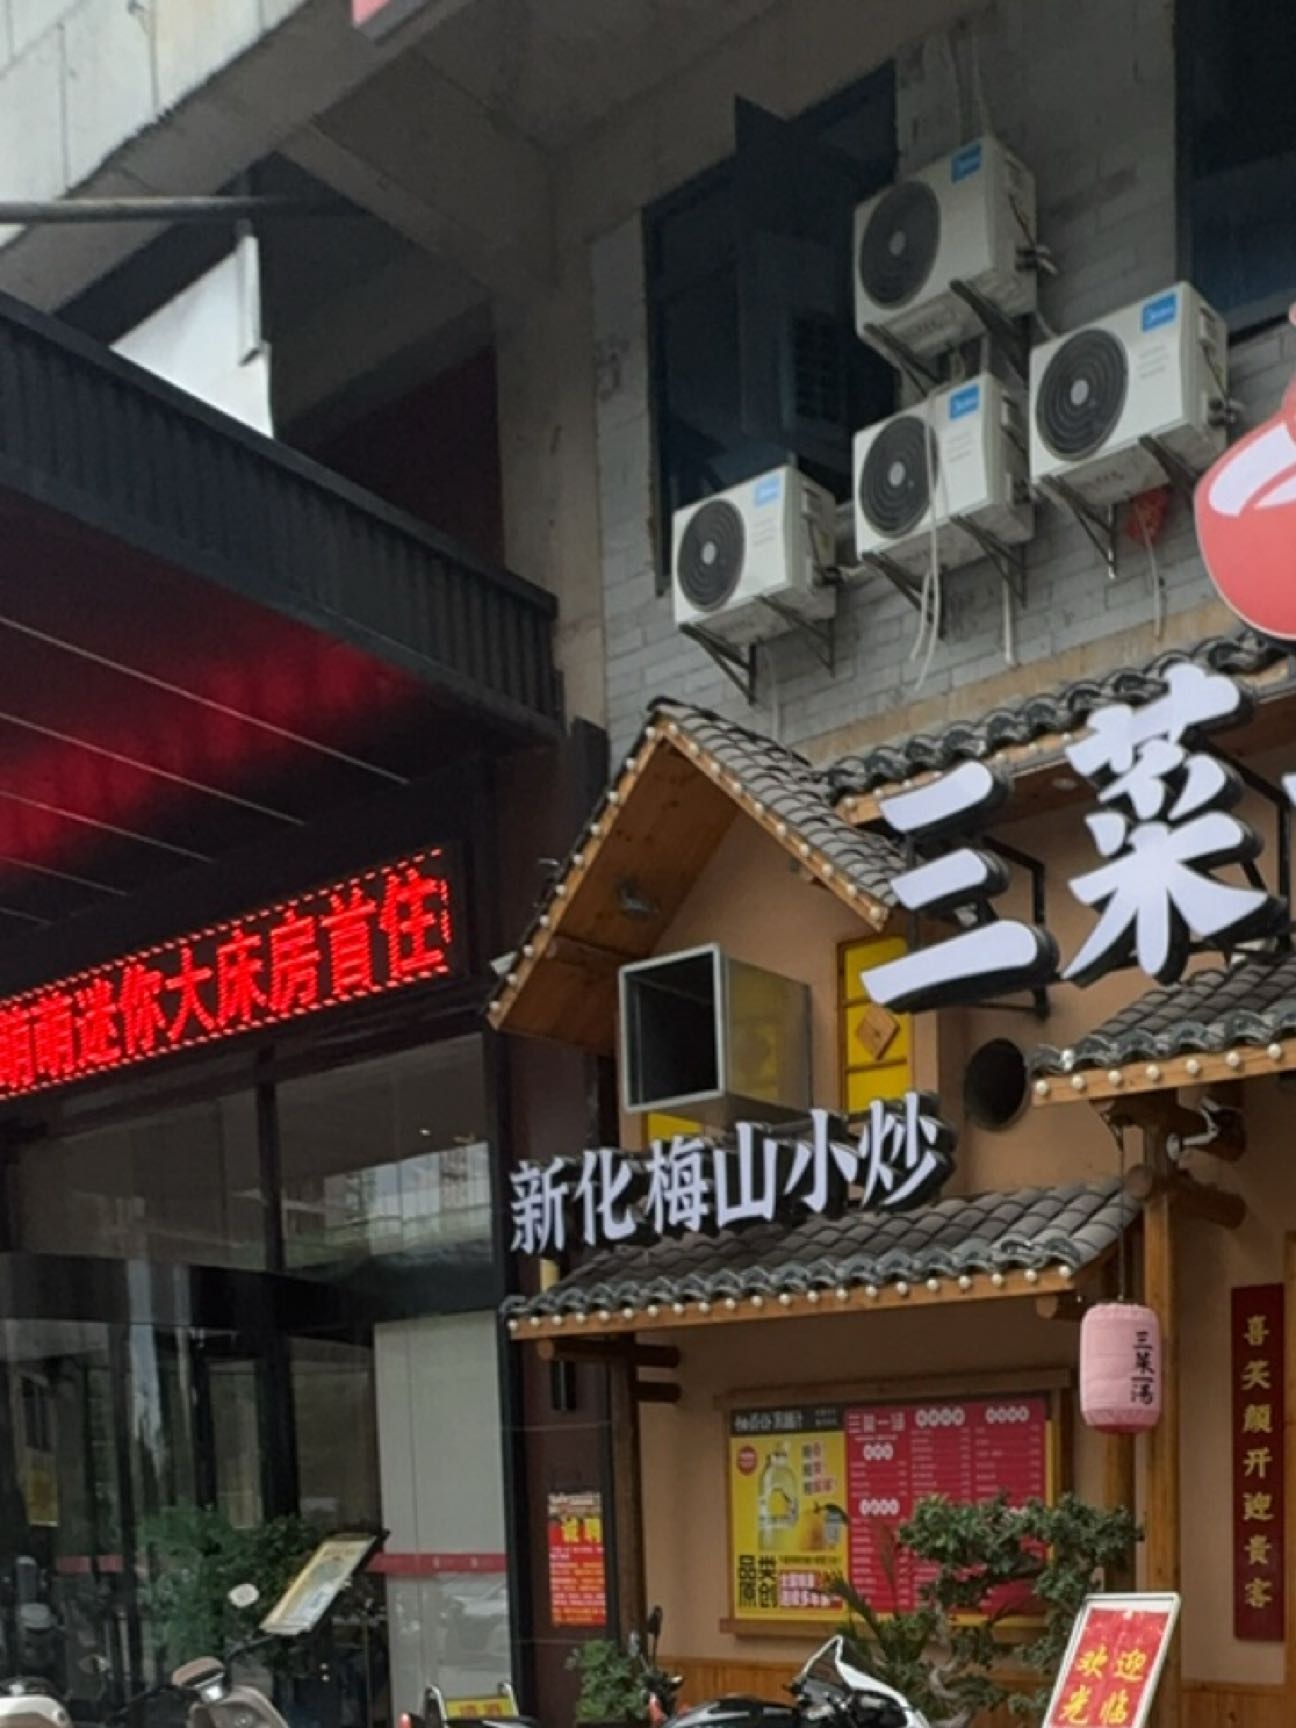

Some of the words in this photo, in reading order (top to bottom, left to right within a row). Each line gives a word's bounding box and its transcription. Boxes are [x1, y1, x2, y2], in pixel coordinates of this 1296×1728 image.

[509, 1091, 938, 1254] 新化梅山小炒
[1130, 1330, 1155, 1406] 三菜一汤
[1075, 1643, 1147, 1684] 欢迎
